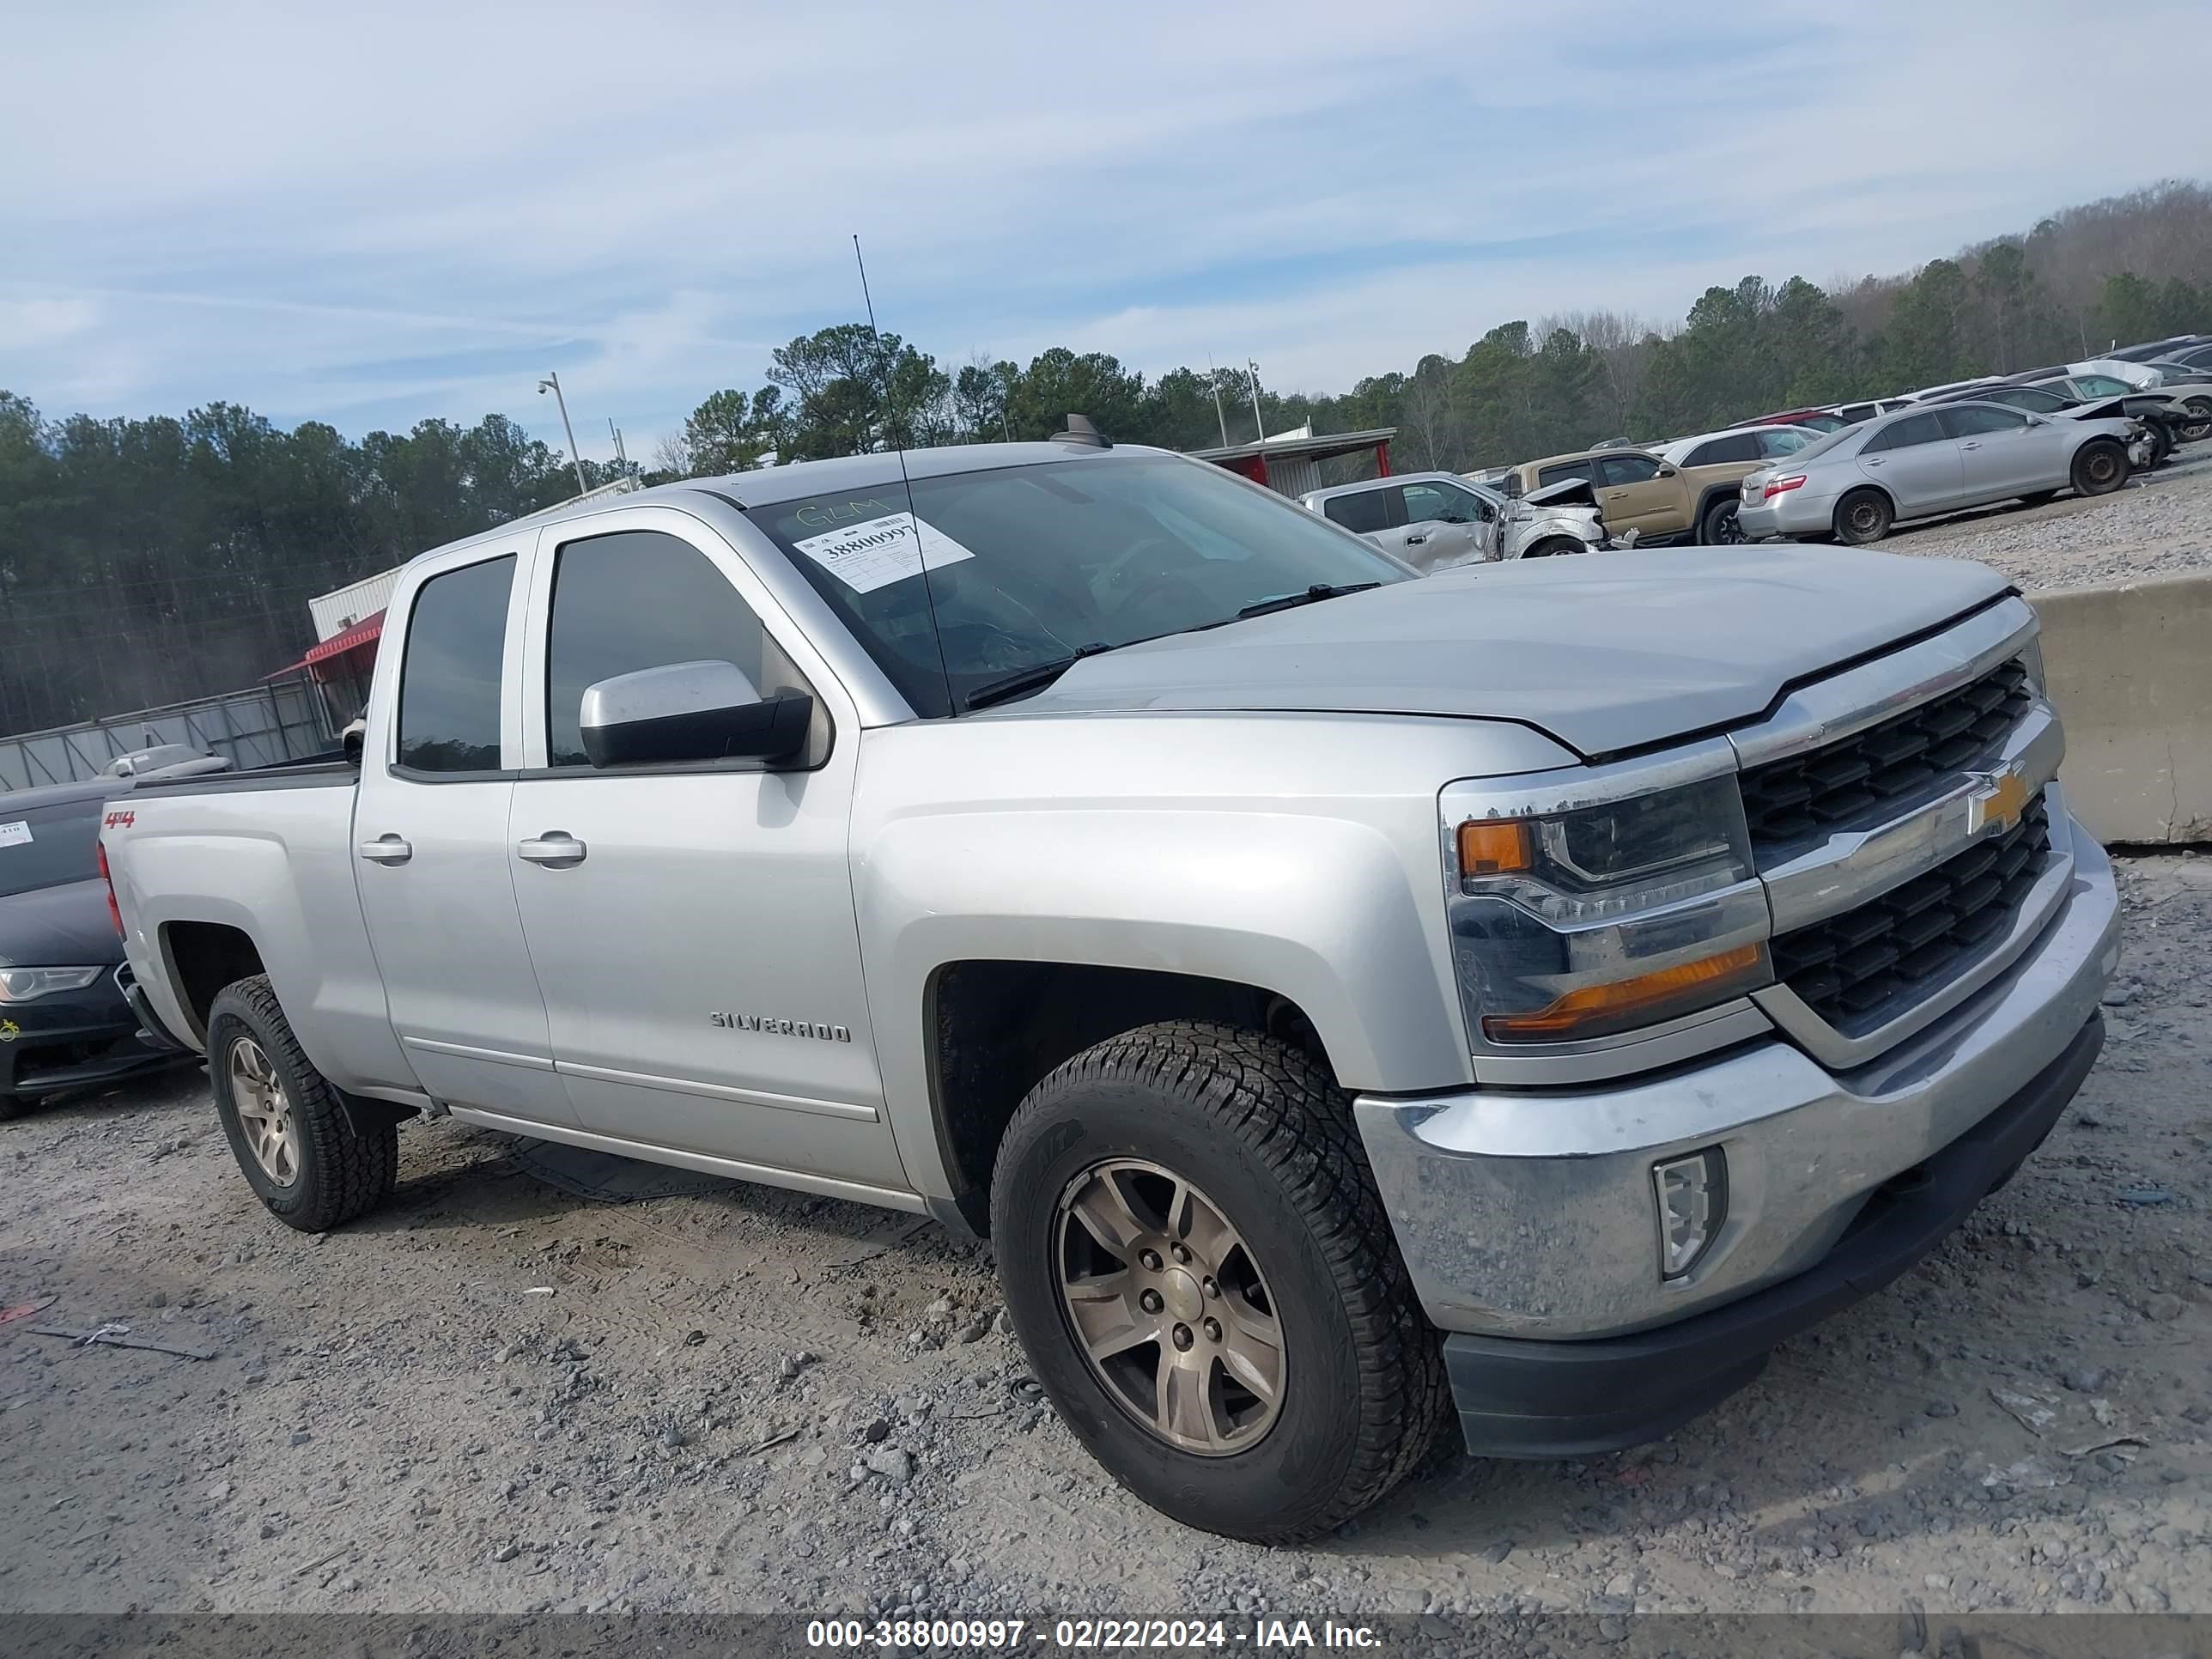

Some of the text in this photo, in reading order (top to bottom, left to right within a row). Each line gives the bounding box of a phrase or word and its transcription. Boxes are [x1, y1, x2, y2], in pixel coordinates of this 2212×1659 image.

[796, 498, 891, 527] GLM
[823, 525, 917, 559] 38800997
[710, 1011, 852, 1043] SILVERADO
